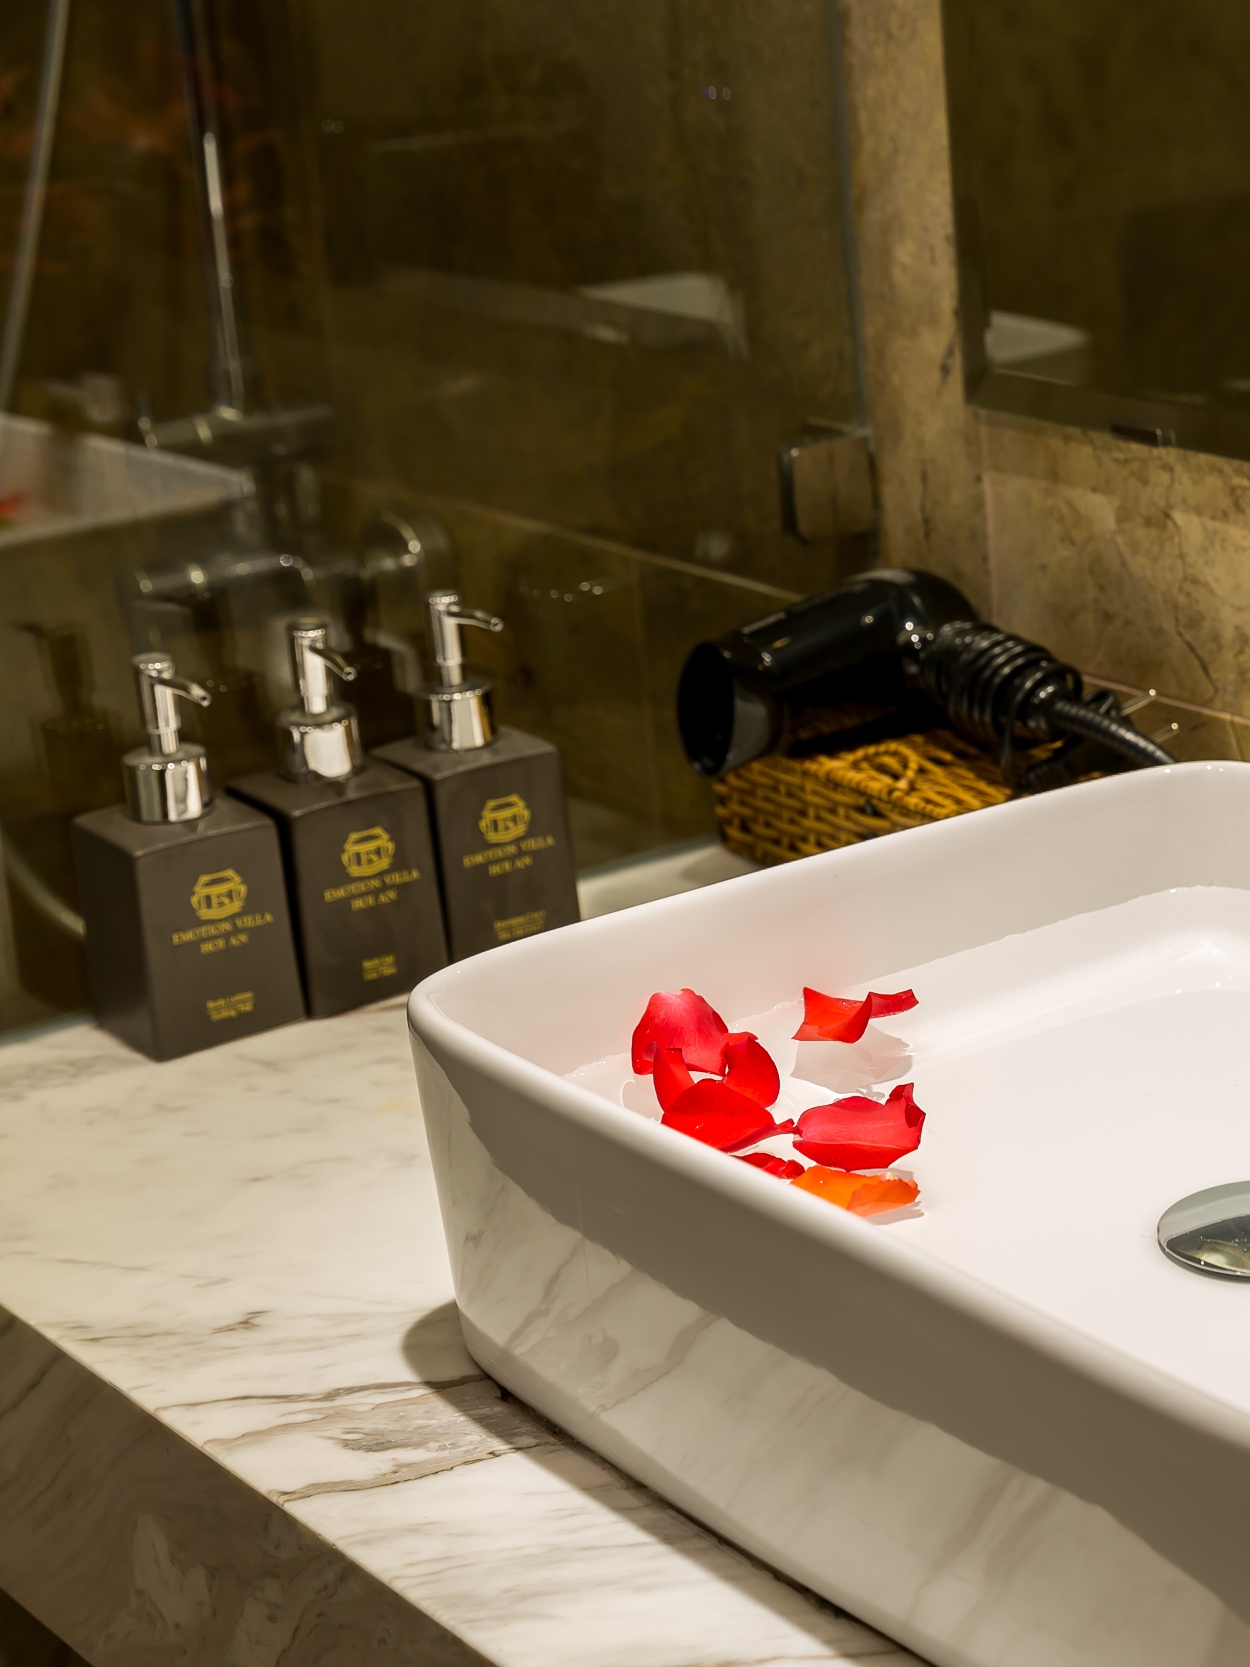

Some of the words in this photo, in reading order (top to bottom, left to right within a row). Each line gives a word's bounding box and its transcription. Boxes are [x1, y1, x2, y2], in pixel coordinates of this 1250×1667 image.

[463, 844, 518, 868] EMOTION
[520, 835, 555, 852] VILLA
[514, 854, 533, 870] AN
[324, 877, 382, 902] EMOTION
[383, 868, 420, 886] VILLA
[378, 888, 398, 905] AN
[172, 921, 233, 946] EMOTION
[235, 912, 274, 929] VILLA
[229, 932, 249, 948] AN
